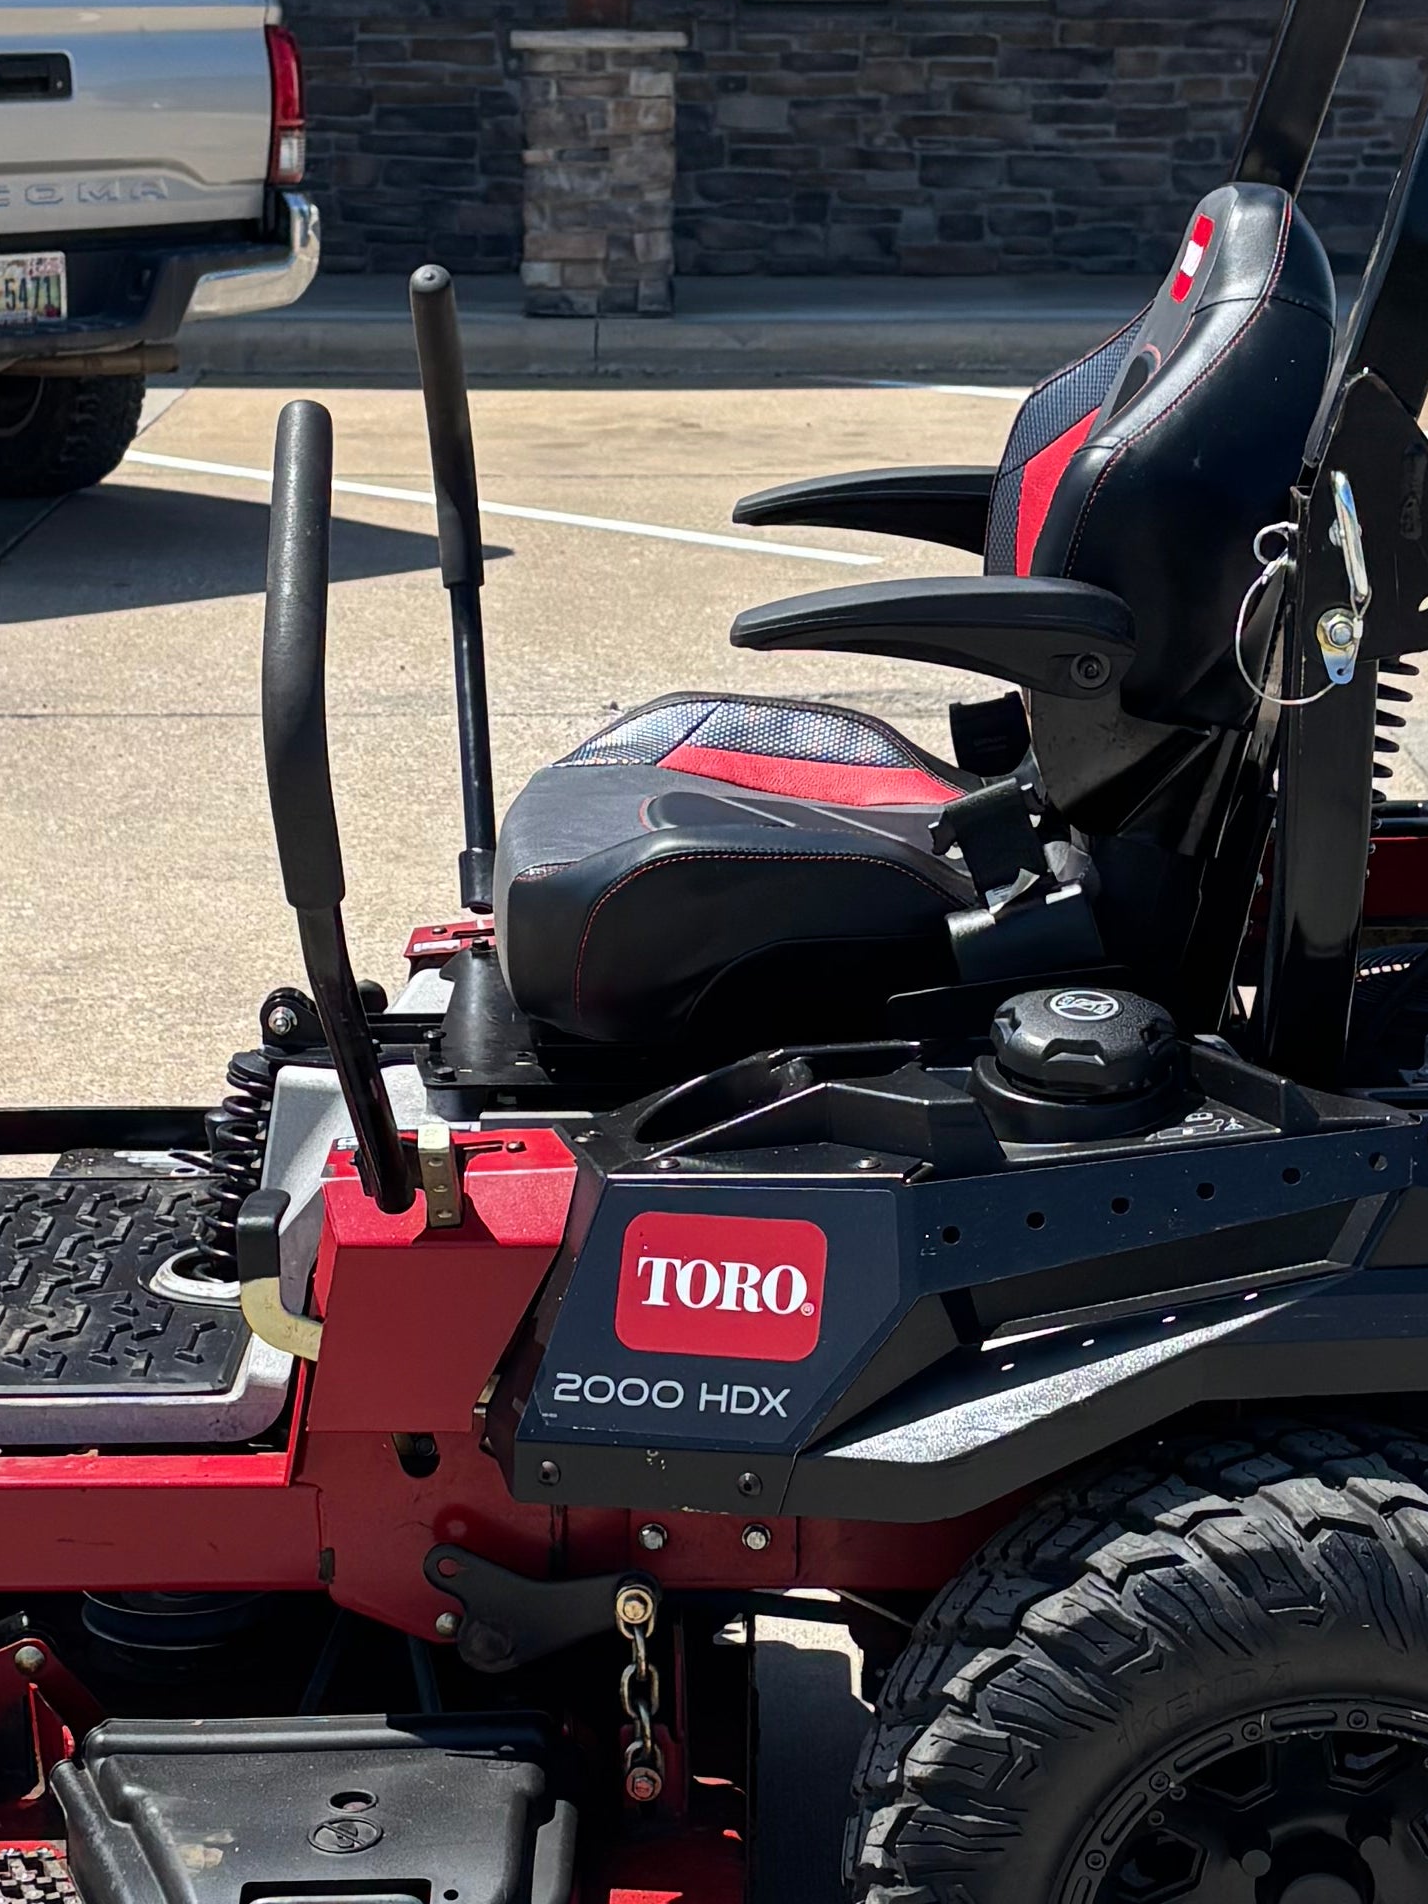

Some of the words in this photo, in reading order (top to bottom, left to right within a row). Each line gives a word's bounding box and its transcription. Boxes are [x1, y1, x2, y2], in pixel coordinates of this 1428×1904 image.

[636, 1256, 808, 1315] TORO
[553, 1372, 685, 1409] 2000
[698, 1382, 791, 1418] HDX
